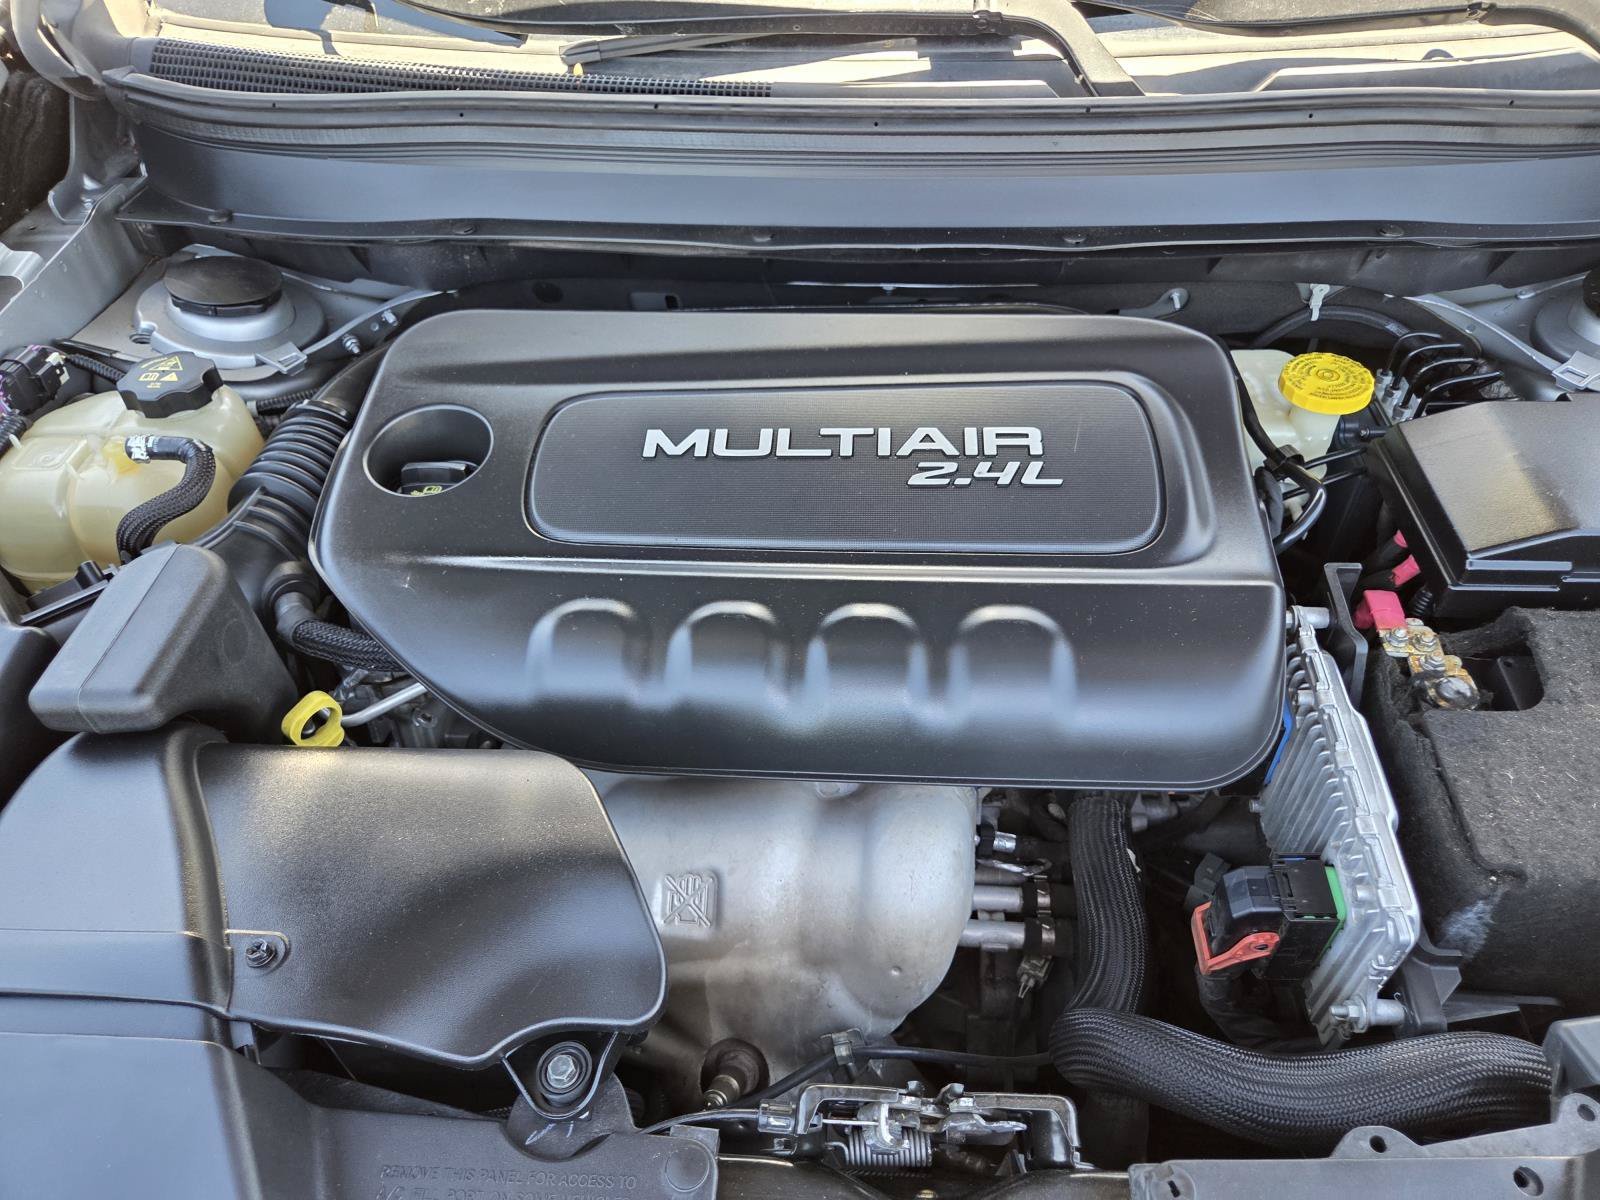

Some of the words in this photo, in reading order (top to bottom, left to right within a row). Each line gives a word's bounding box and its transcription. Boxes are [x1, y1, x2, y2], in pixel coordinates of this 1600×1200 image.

[641, 426, 1045, 458] MULTIAIR
[907, 460, 1064, 487] 2.4L
[380, 1165, 440, 1180] REMOVE
[443, 1167, 476, 1181] THIS
[480, 1168, 523, 1184] PANEL
[527, 1171, 556, 1185] FOR
[559, 1174, 615, 1189] ACCESS
[619, 1176, 638, 1190] TO
